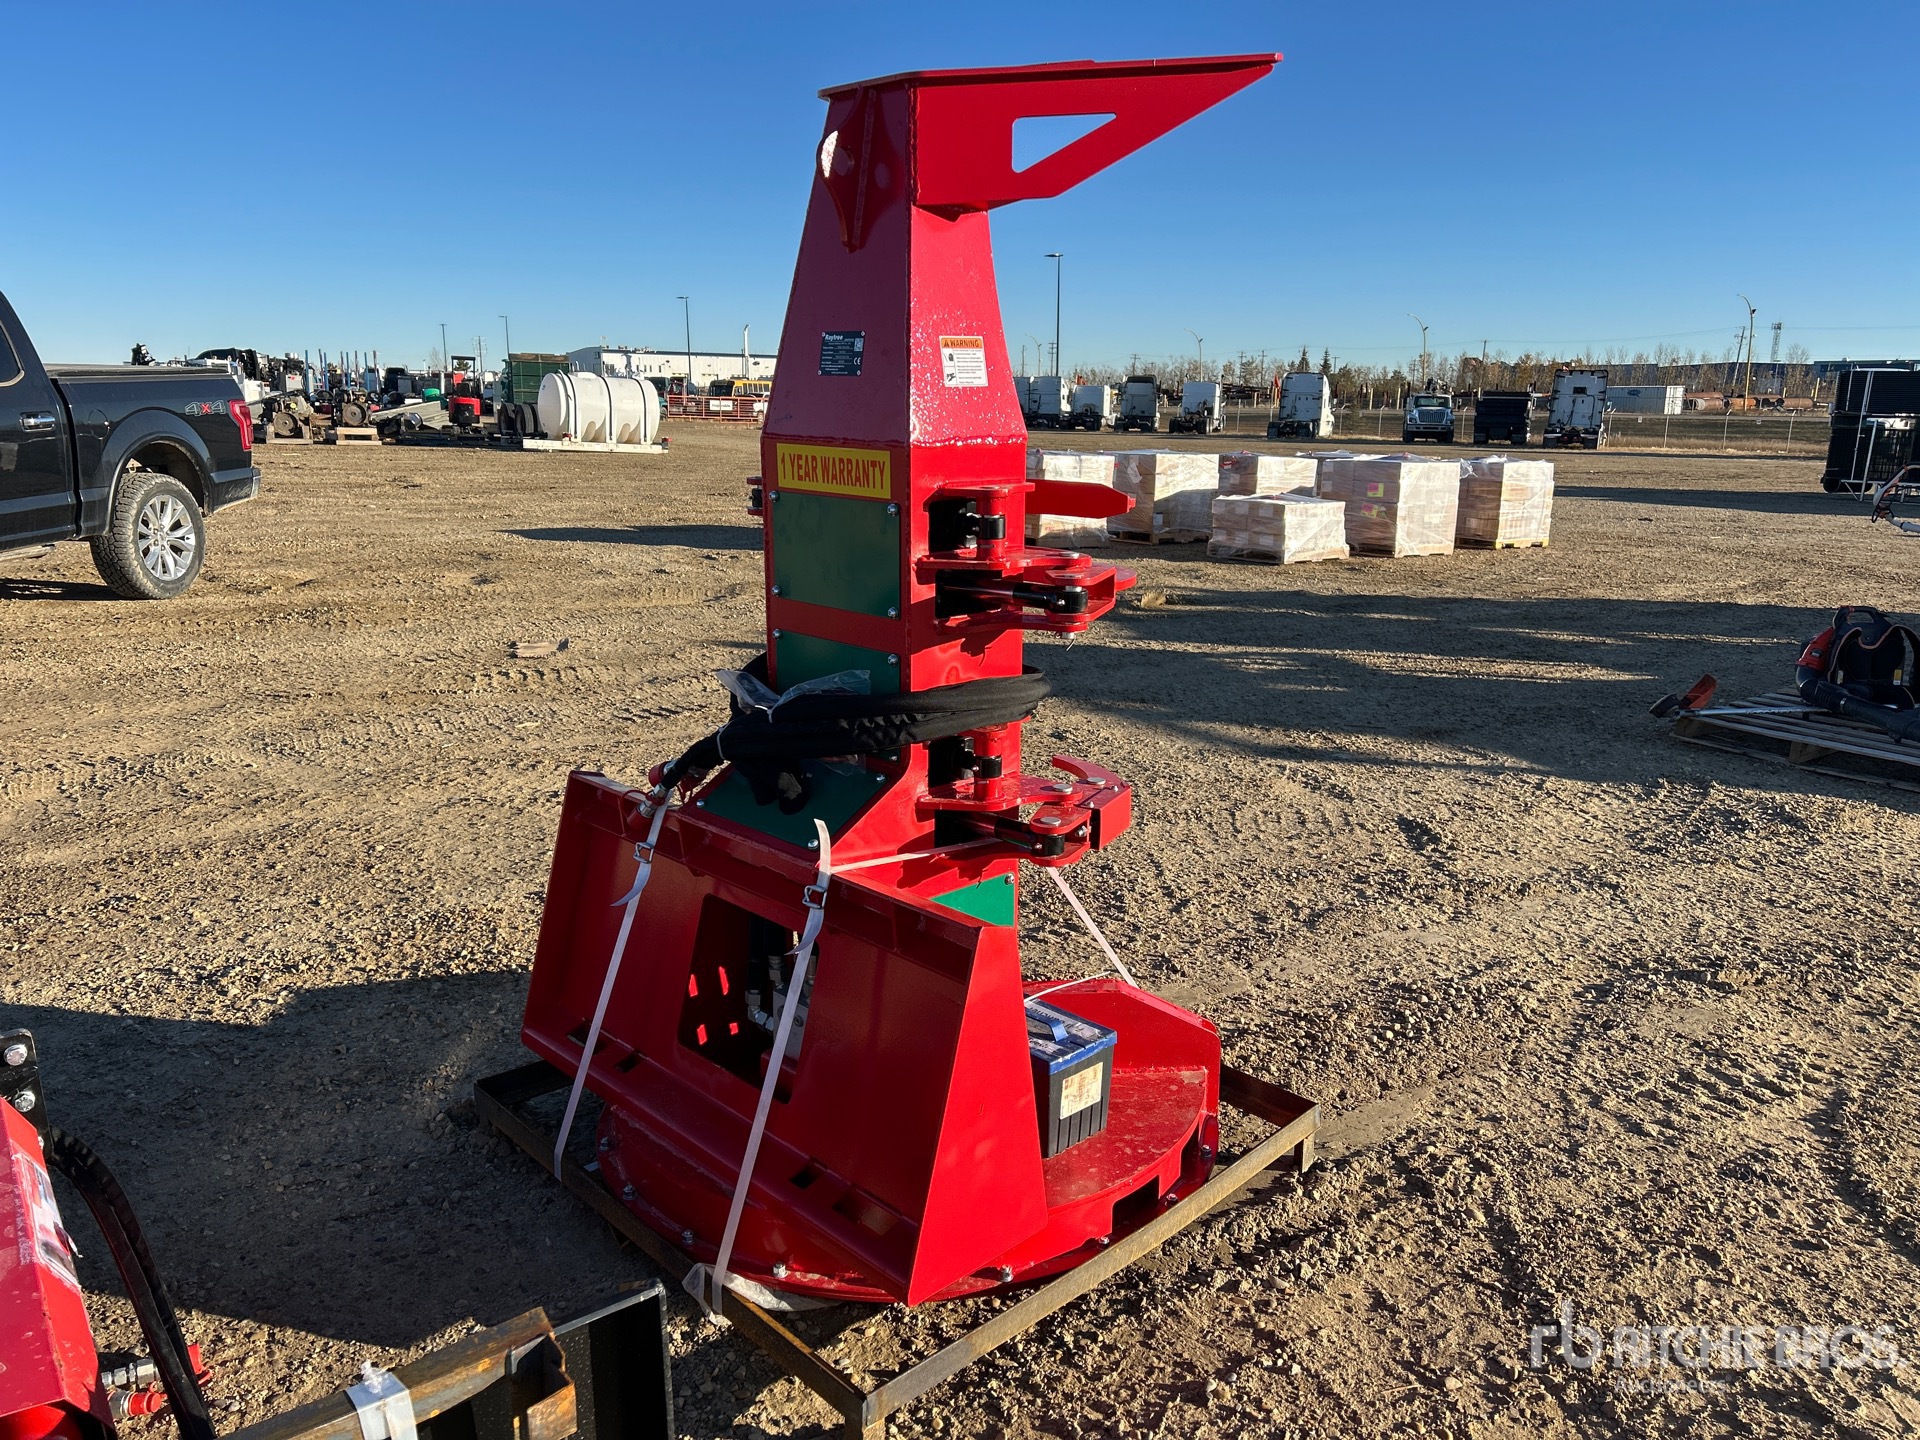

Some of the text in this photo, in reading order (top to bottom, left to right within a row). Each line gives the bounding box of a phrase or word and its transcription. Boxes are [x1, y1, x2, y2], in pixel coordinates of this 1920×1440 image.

[950, 339, 980, 348] WARNING
[781, 452, 886, 490] 1 YEAR WARRANTY
